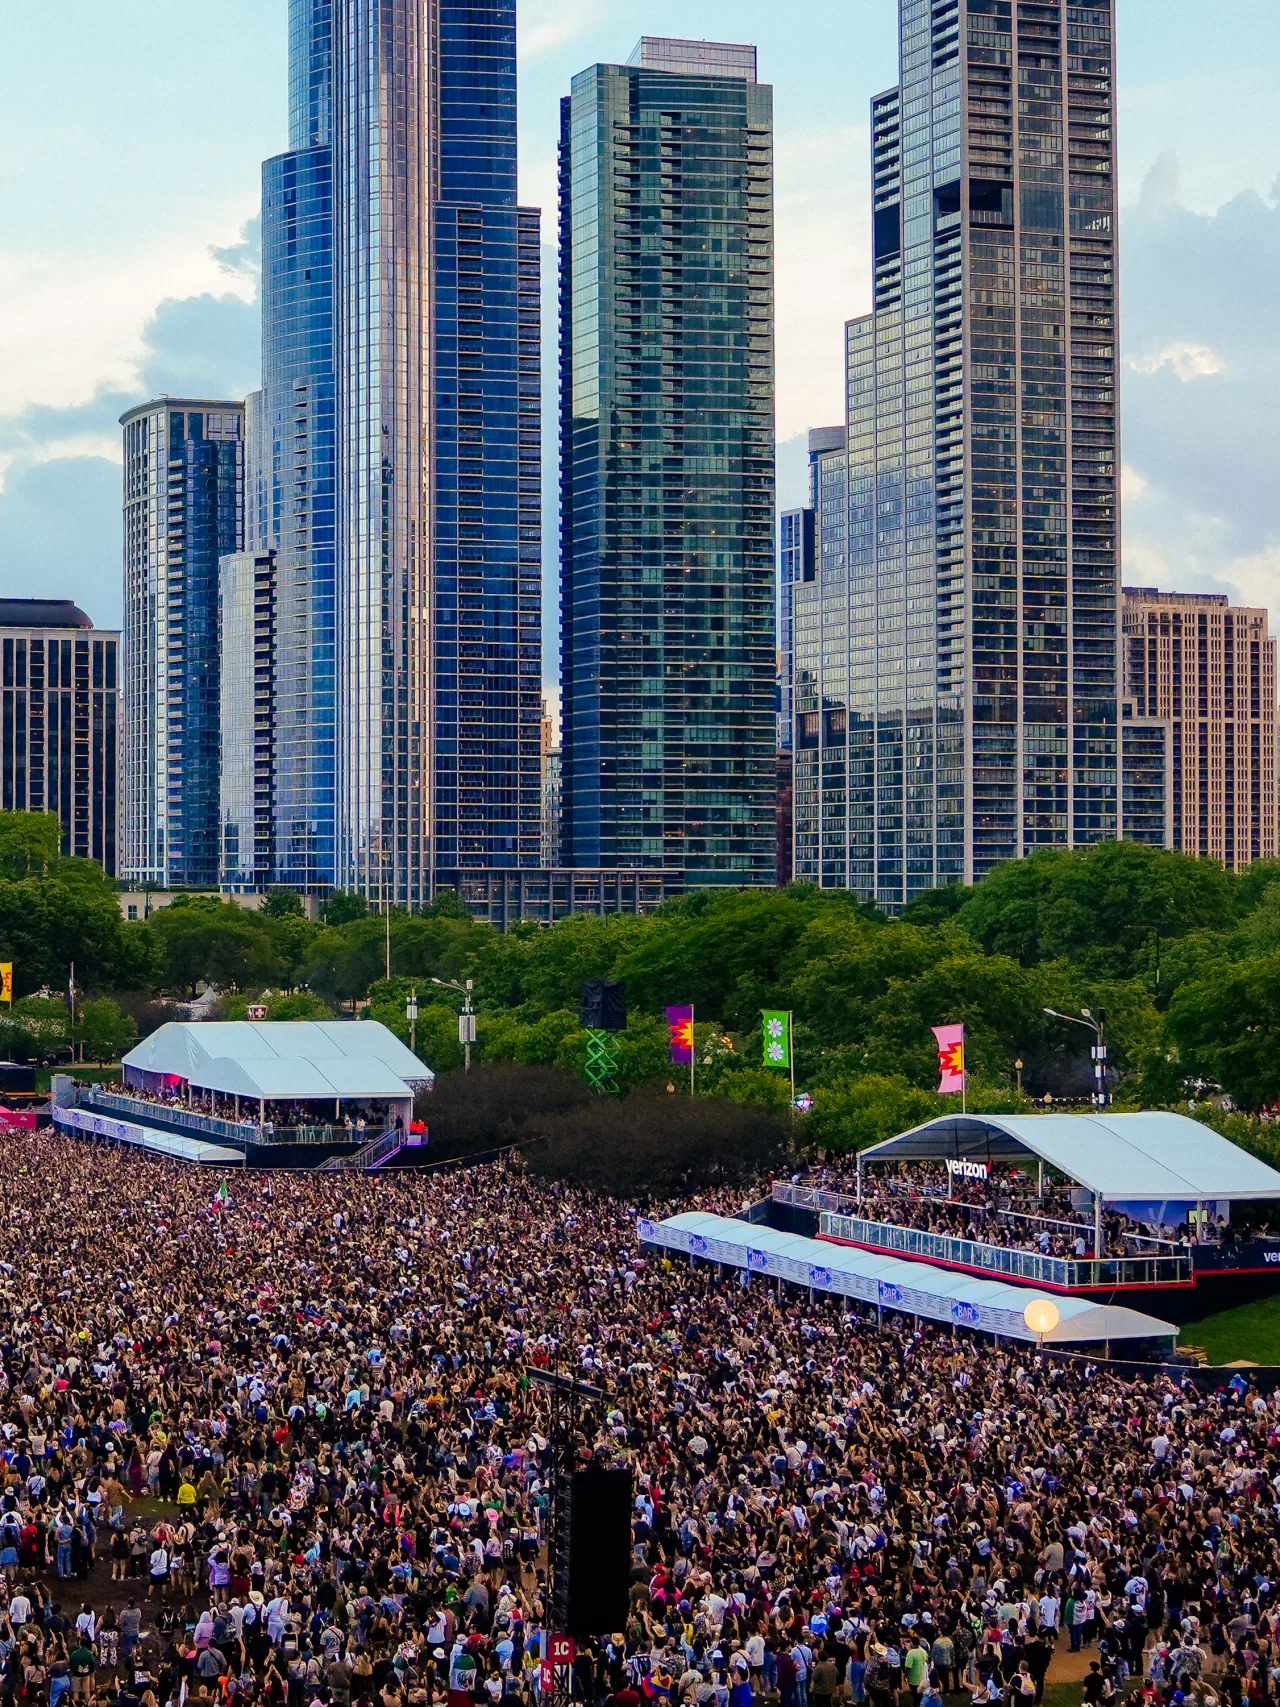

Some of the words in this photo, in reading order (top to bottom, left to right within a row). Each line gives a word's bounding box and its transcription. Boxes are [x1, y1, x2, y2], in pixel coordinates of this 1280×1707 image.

[945, 1157, 987, 1179] verizon
[814, 1269, 827, 1282] BAR
[883, 1286, 896, 1299] BAR
[957, 1305, 973, 1320] BAR
[553, 1641, 570, 1656] 1C
[543, 1667, 551, 1684] 1C
